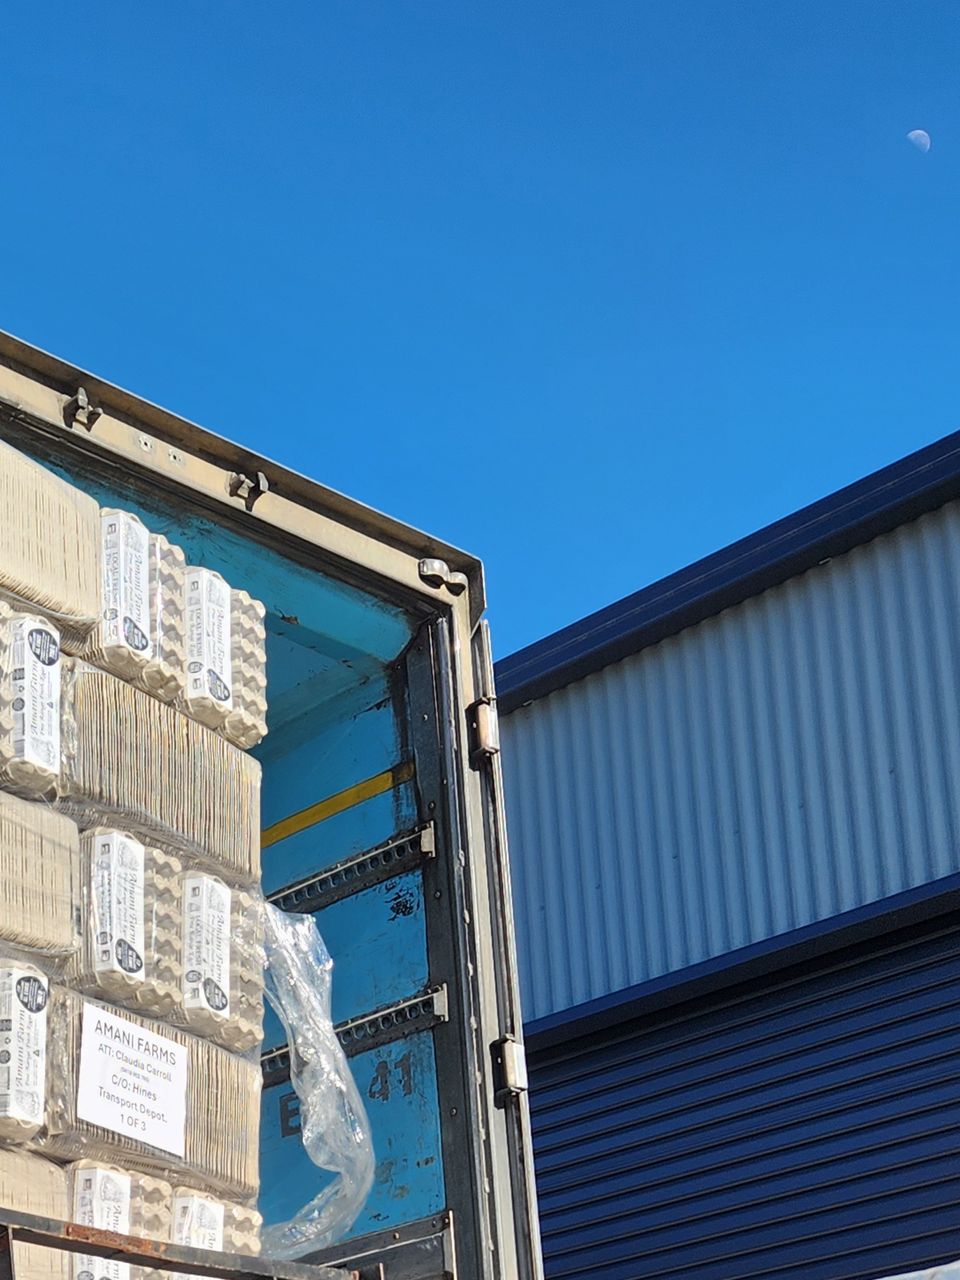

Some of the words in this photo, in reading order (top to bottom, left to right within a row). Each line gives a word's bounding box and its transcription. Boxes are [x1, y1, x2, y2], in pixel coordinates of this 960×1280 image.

[133, 555, 142, 590] Amani
[135, 594, 143, 623] Farm
[130, 874, 138, 910] Amani
[129, 914, 137, 944] Farm
[217, 913, 225, 949] Amani
[216, 953, 224, 983] Farm
[17, 1009, 26, 1043] Farm
[95, 1020, 134, 1047] AMANI
[138, 1038, 176, 1066] FARMS
[16, 1048, 24, 1088] Amani
[98, 1044, 114, 1057] ATT:
[116, 1050, 144, 1070] Claudia
[99, 1086, 138, 1112] Transport
[140, 1104, 168, 1122] Depot.
[112, 1074, 130, 1091] C/O:
[132, 1083, 156, 1101] Hines
[120, 1114, 124, 1124] 1
[127, 1116, 140, 1128] OF
[141, 1121, 146, 1131] 3
